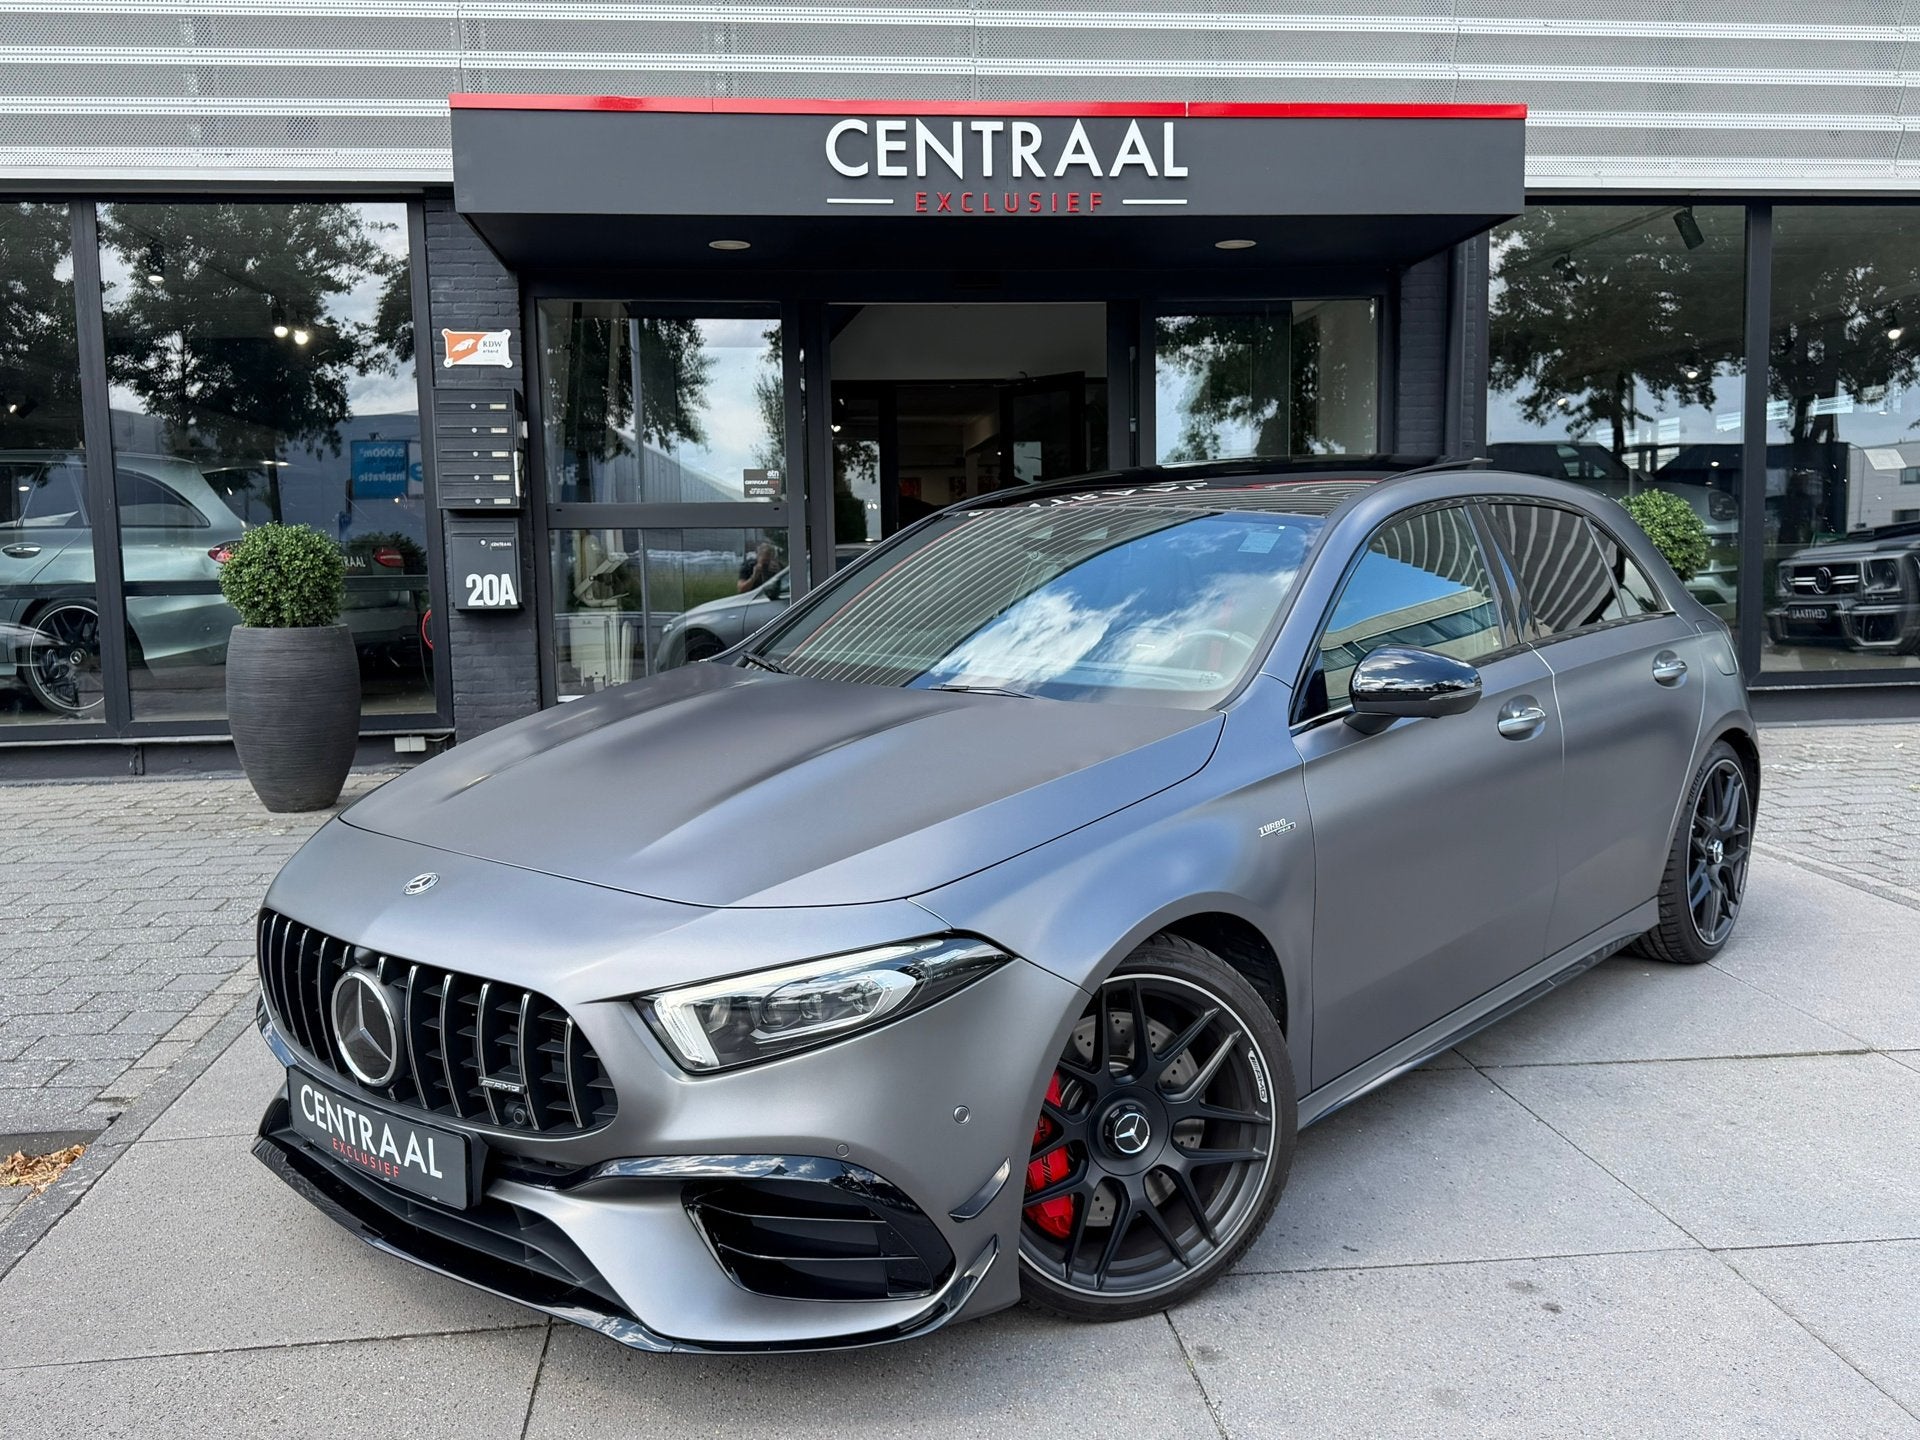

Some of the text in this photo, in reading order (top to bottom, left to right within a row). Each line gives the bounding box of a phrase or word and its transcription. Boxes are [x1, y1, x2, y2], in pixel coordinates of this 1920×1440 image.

[825, 118, 1189, 180] CENTRAAL
[915, 192, 1104, 213] EXCLUSIEF
[482, 340, 503, 348] RDW
[465, 573, 518, 606] 20A
[1259, 818, 1287, 836] TURBO
[300, 1083, 443, 1180] CENTRAAL
[332, 1137, 401, 1178] EXCLUSIEF
